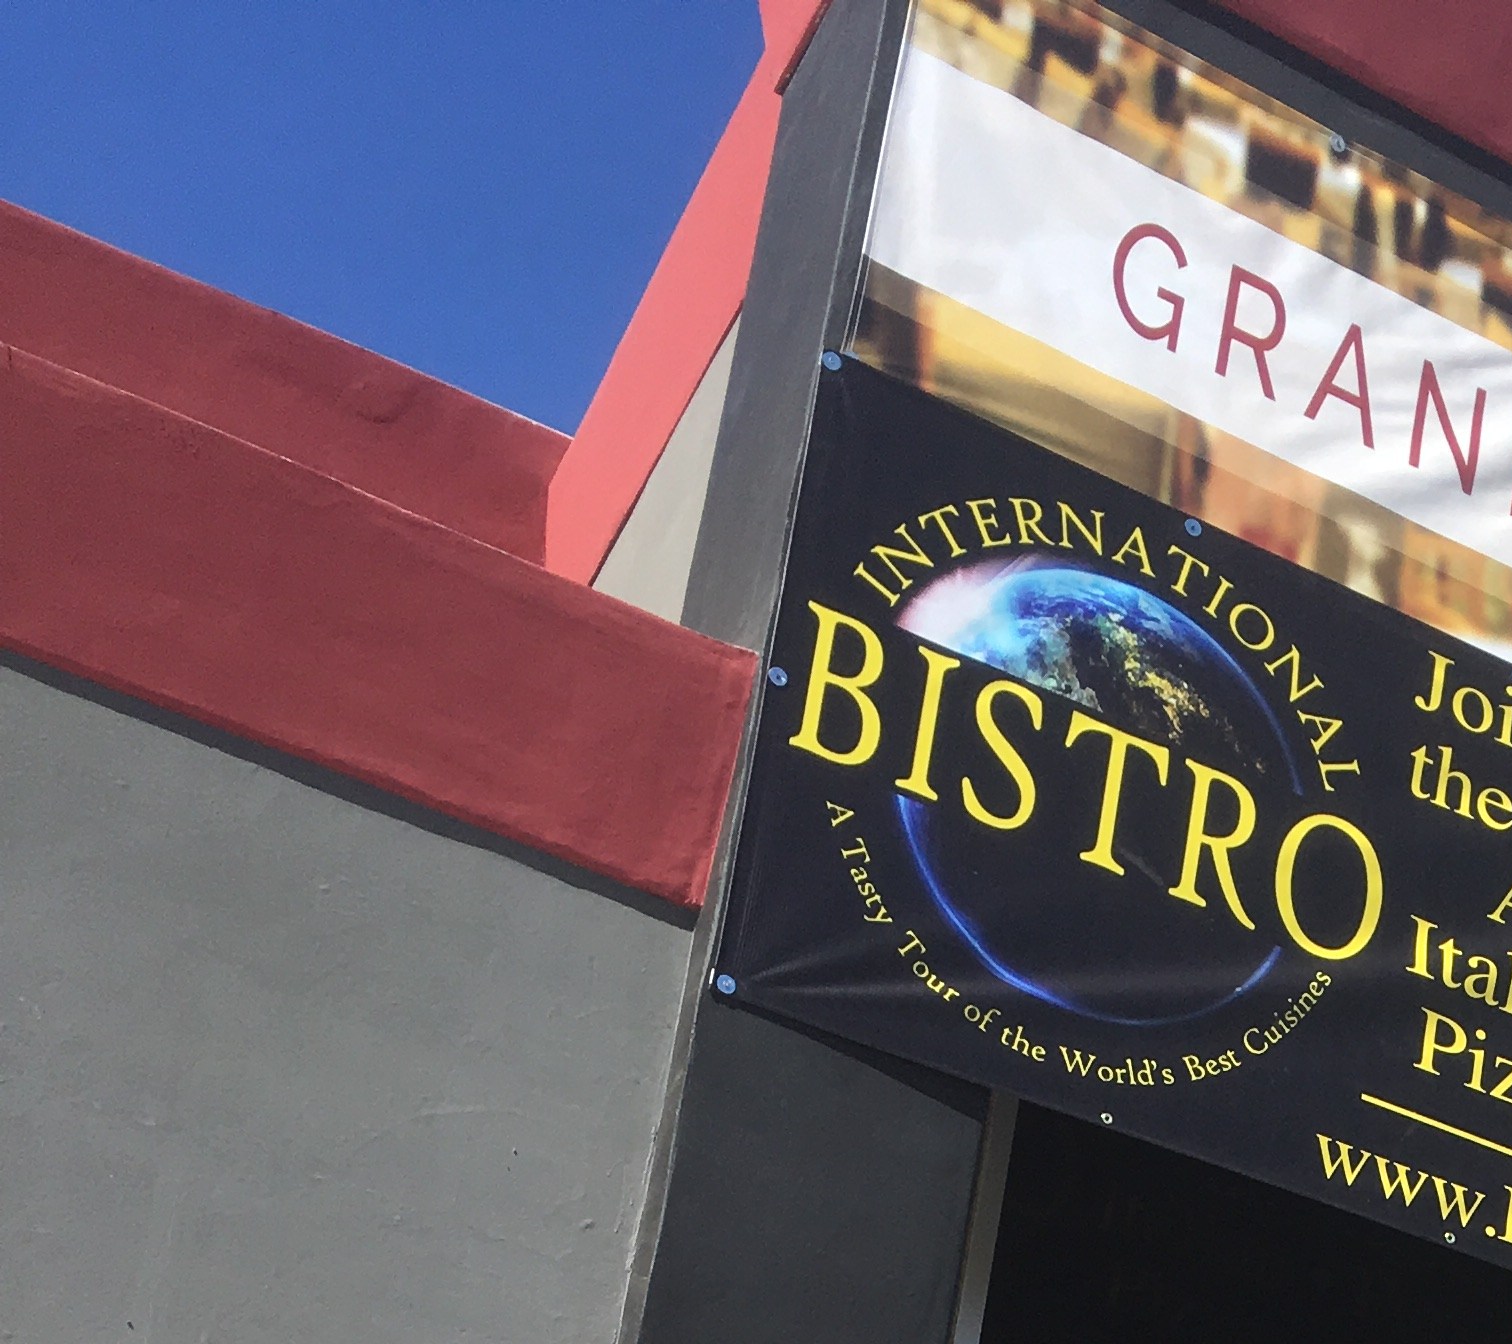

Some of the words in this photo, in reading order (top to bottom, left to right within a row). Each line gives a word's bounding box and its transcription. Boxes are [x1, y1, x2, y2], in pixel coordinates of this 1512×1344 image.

[789, 601, 1383, 960] BISTRO
[854, 497, 1360, 792] INTERNATIONAL
[1411, 746, 1512, 830] the
[826, 801, 855, 827] A
[841, 838, 893, 926] Tasty
[898, 930, 960, 1002] Tour
[963, 1003, 998, 1033] of
[1000, 1025, 1046, 1062] the
[1059, 1045, 1175, 1087] World's
[1185, 1047, 1241, 1083] Best
[1242, 967, 1333, 1055] Cuisines
